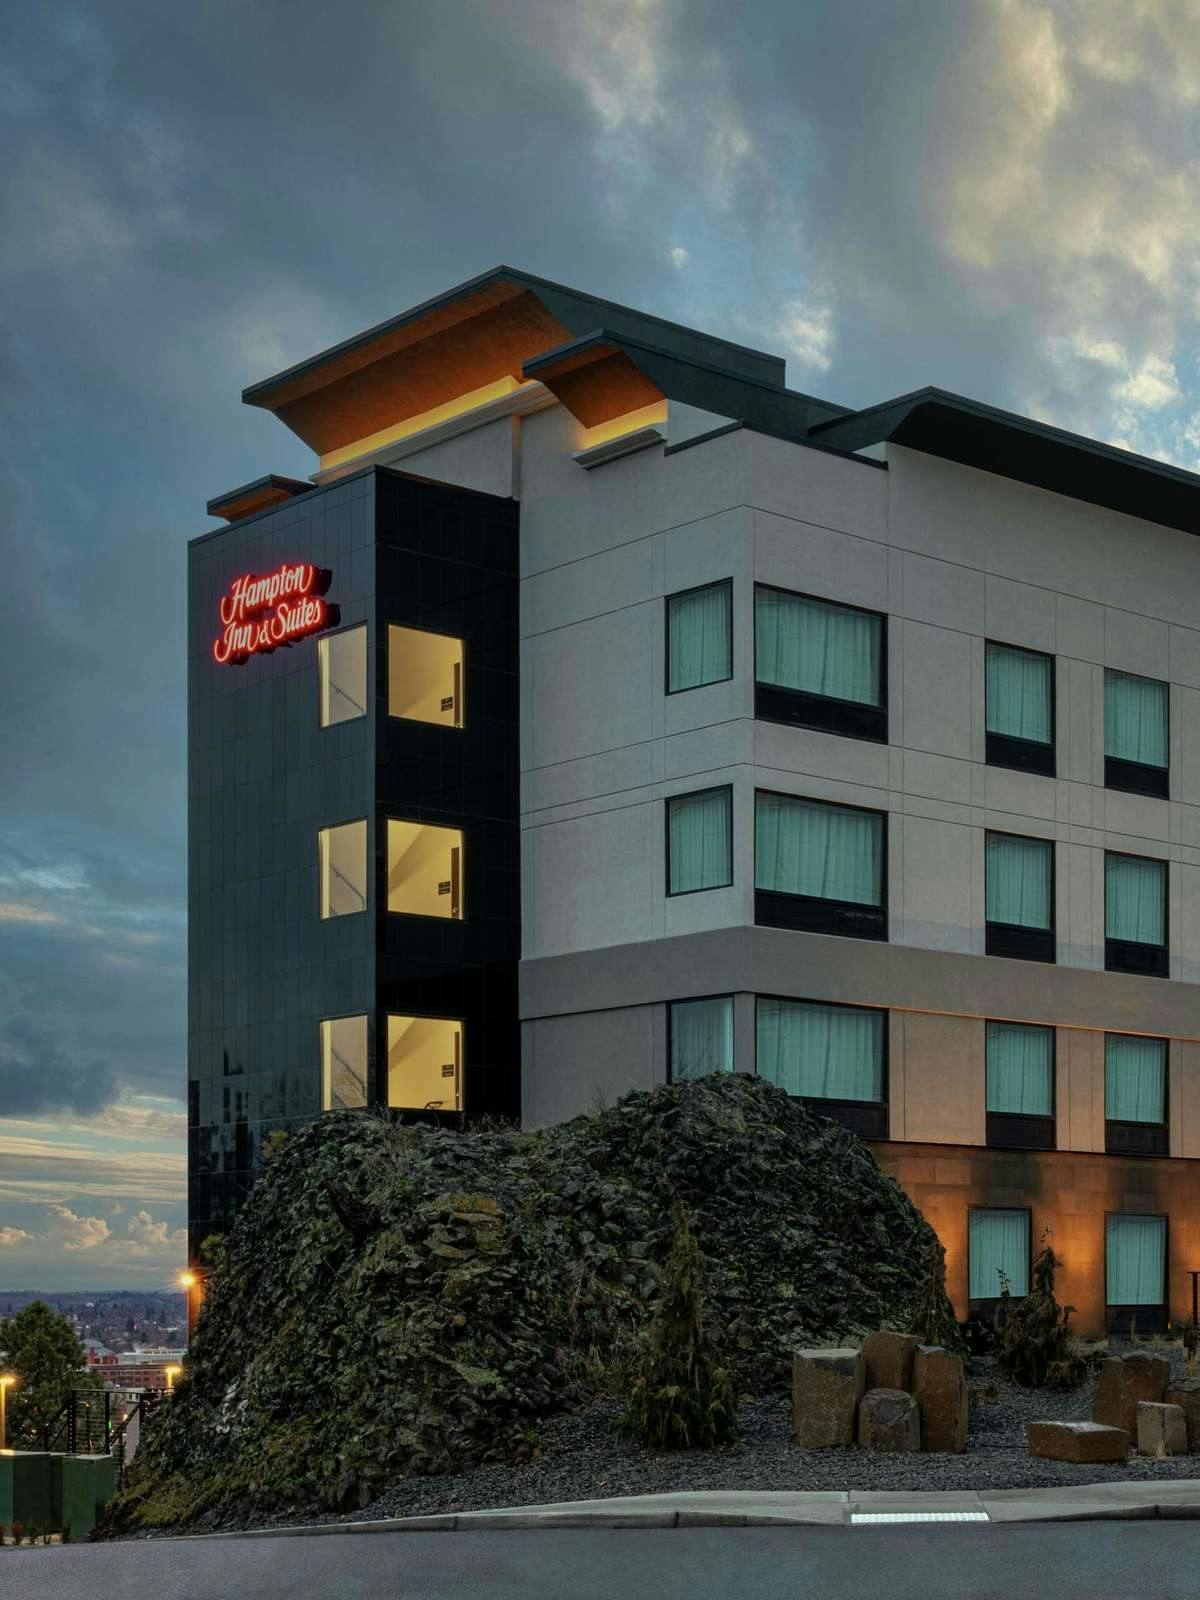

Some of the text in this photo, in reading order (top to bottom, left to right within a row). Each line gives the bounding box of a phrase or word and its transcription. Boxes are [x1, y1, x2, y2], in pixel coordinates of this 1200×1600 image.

[221, 565, 313, 624] Hampton
[214, 597, 321, 662] Inn & Suites
